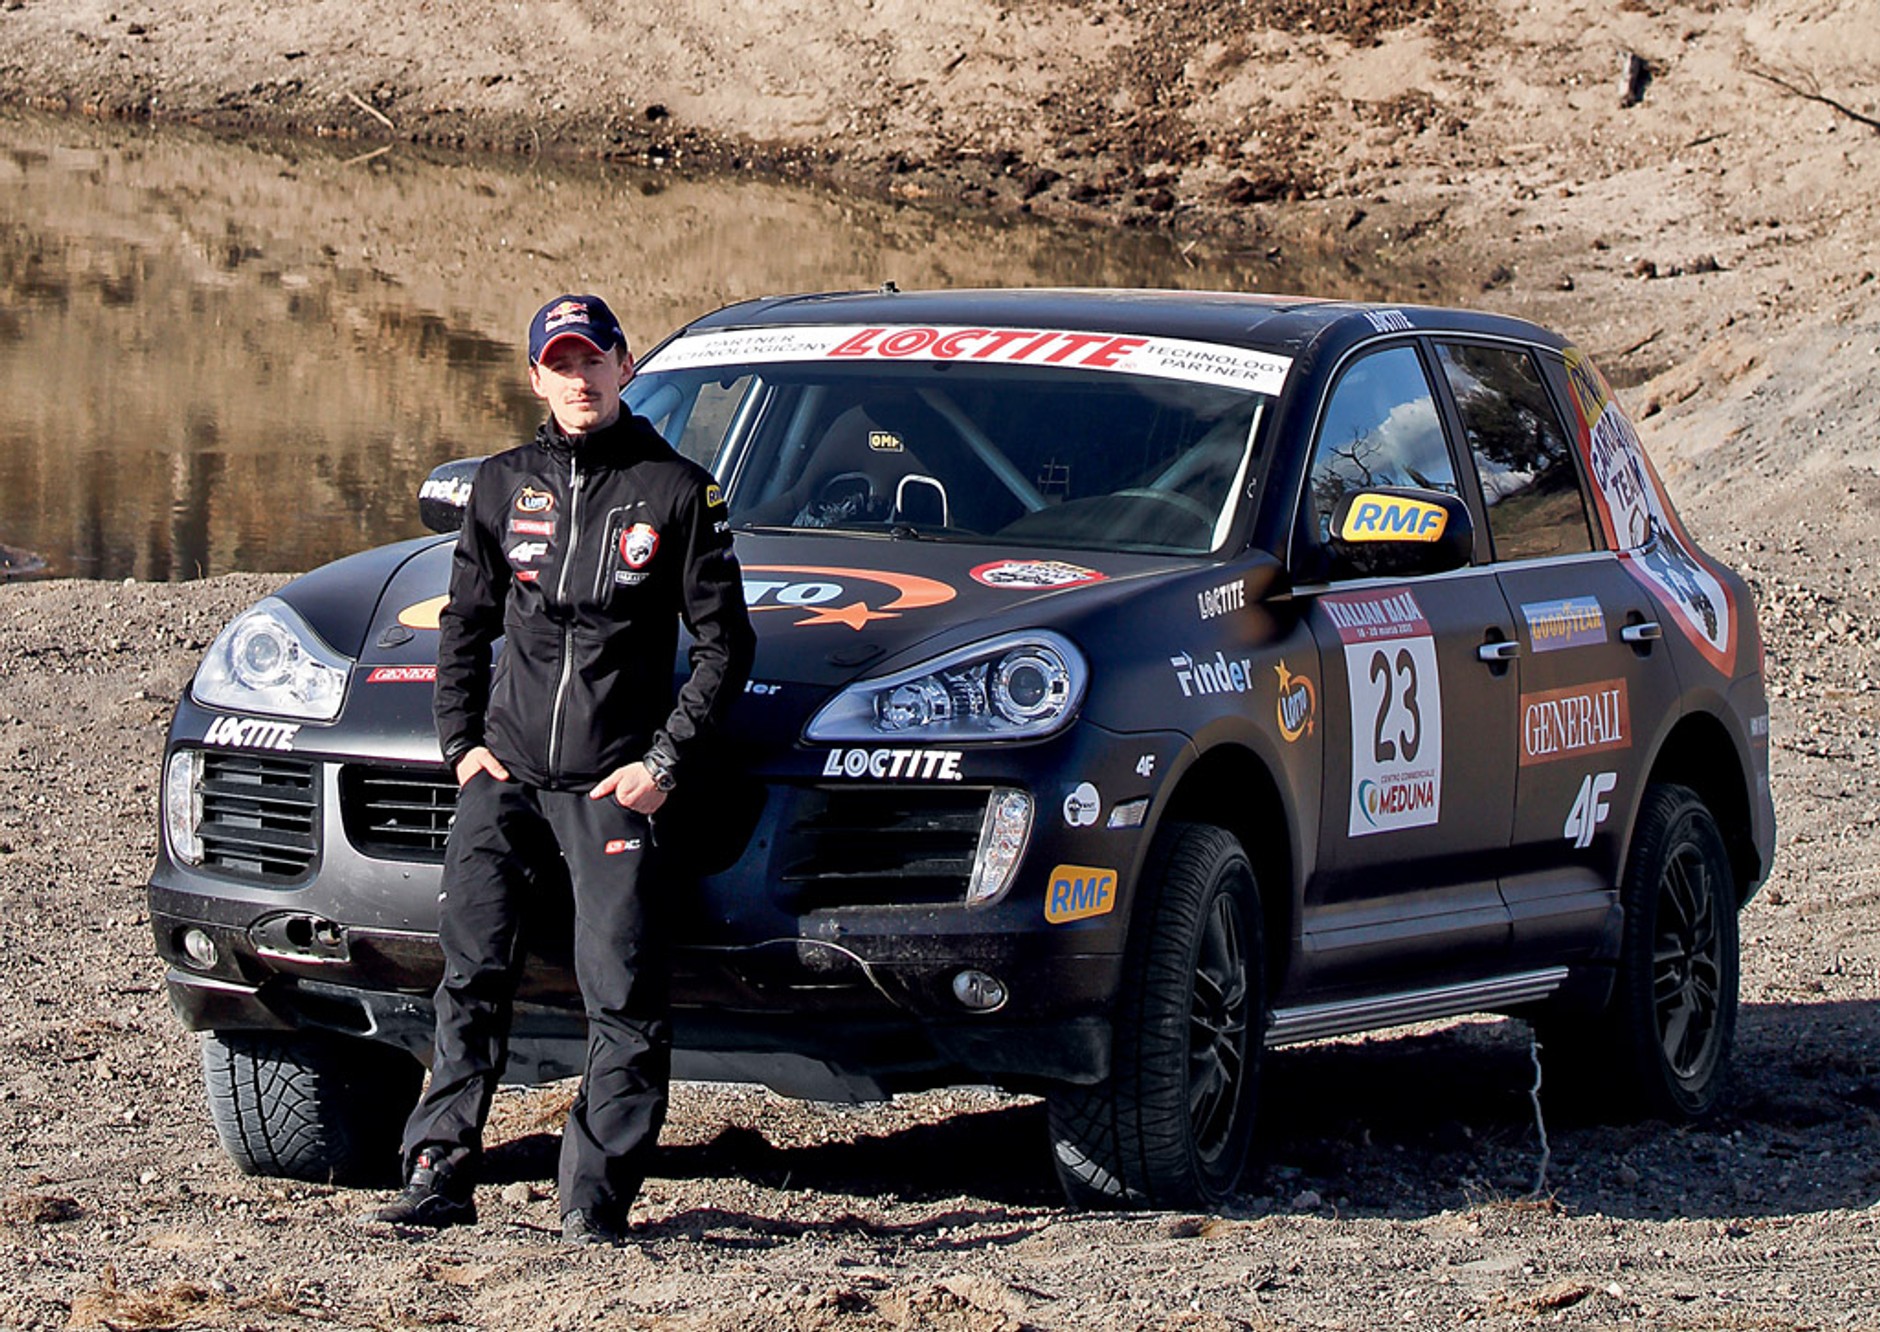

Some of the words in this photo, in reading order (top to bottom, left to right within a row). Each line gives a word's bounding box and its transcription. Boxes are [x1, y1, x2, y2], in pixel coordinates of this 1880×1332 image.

[705, 334, 795, 349] PARTNER
[826, 328, 1150, 368] LOCTITE
[1147, 345, 1289, 374] TECHNOLOGY
[1160, 358, 1259, 380] PARTNER
[1353, 503, 1443, 534] RMF
[1197, 579, 1245, 620] LOCTITE
[1322, 600, 1387, 628] ITALIAN
[1382, 592, 1424, 623] BAJA
[1532, 606, 1603, 641] GOODYEAR
[1170, 651, 1253, 697] Finder
[1370, 648, 1421, 763] 23
[1525, 689, 1622, 756] GENERALI
[203, 716, 302, 751] LOCTITE
[823, 749, 963, 780] LOCTITE
[1136, 754, 1155, 777] 4F
[1379, 780, 1434, 815] MEDUNA
[1564, 772, 1617, 849] 4F
[1052, 876, 1113, 914] RMF
